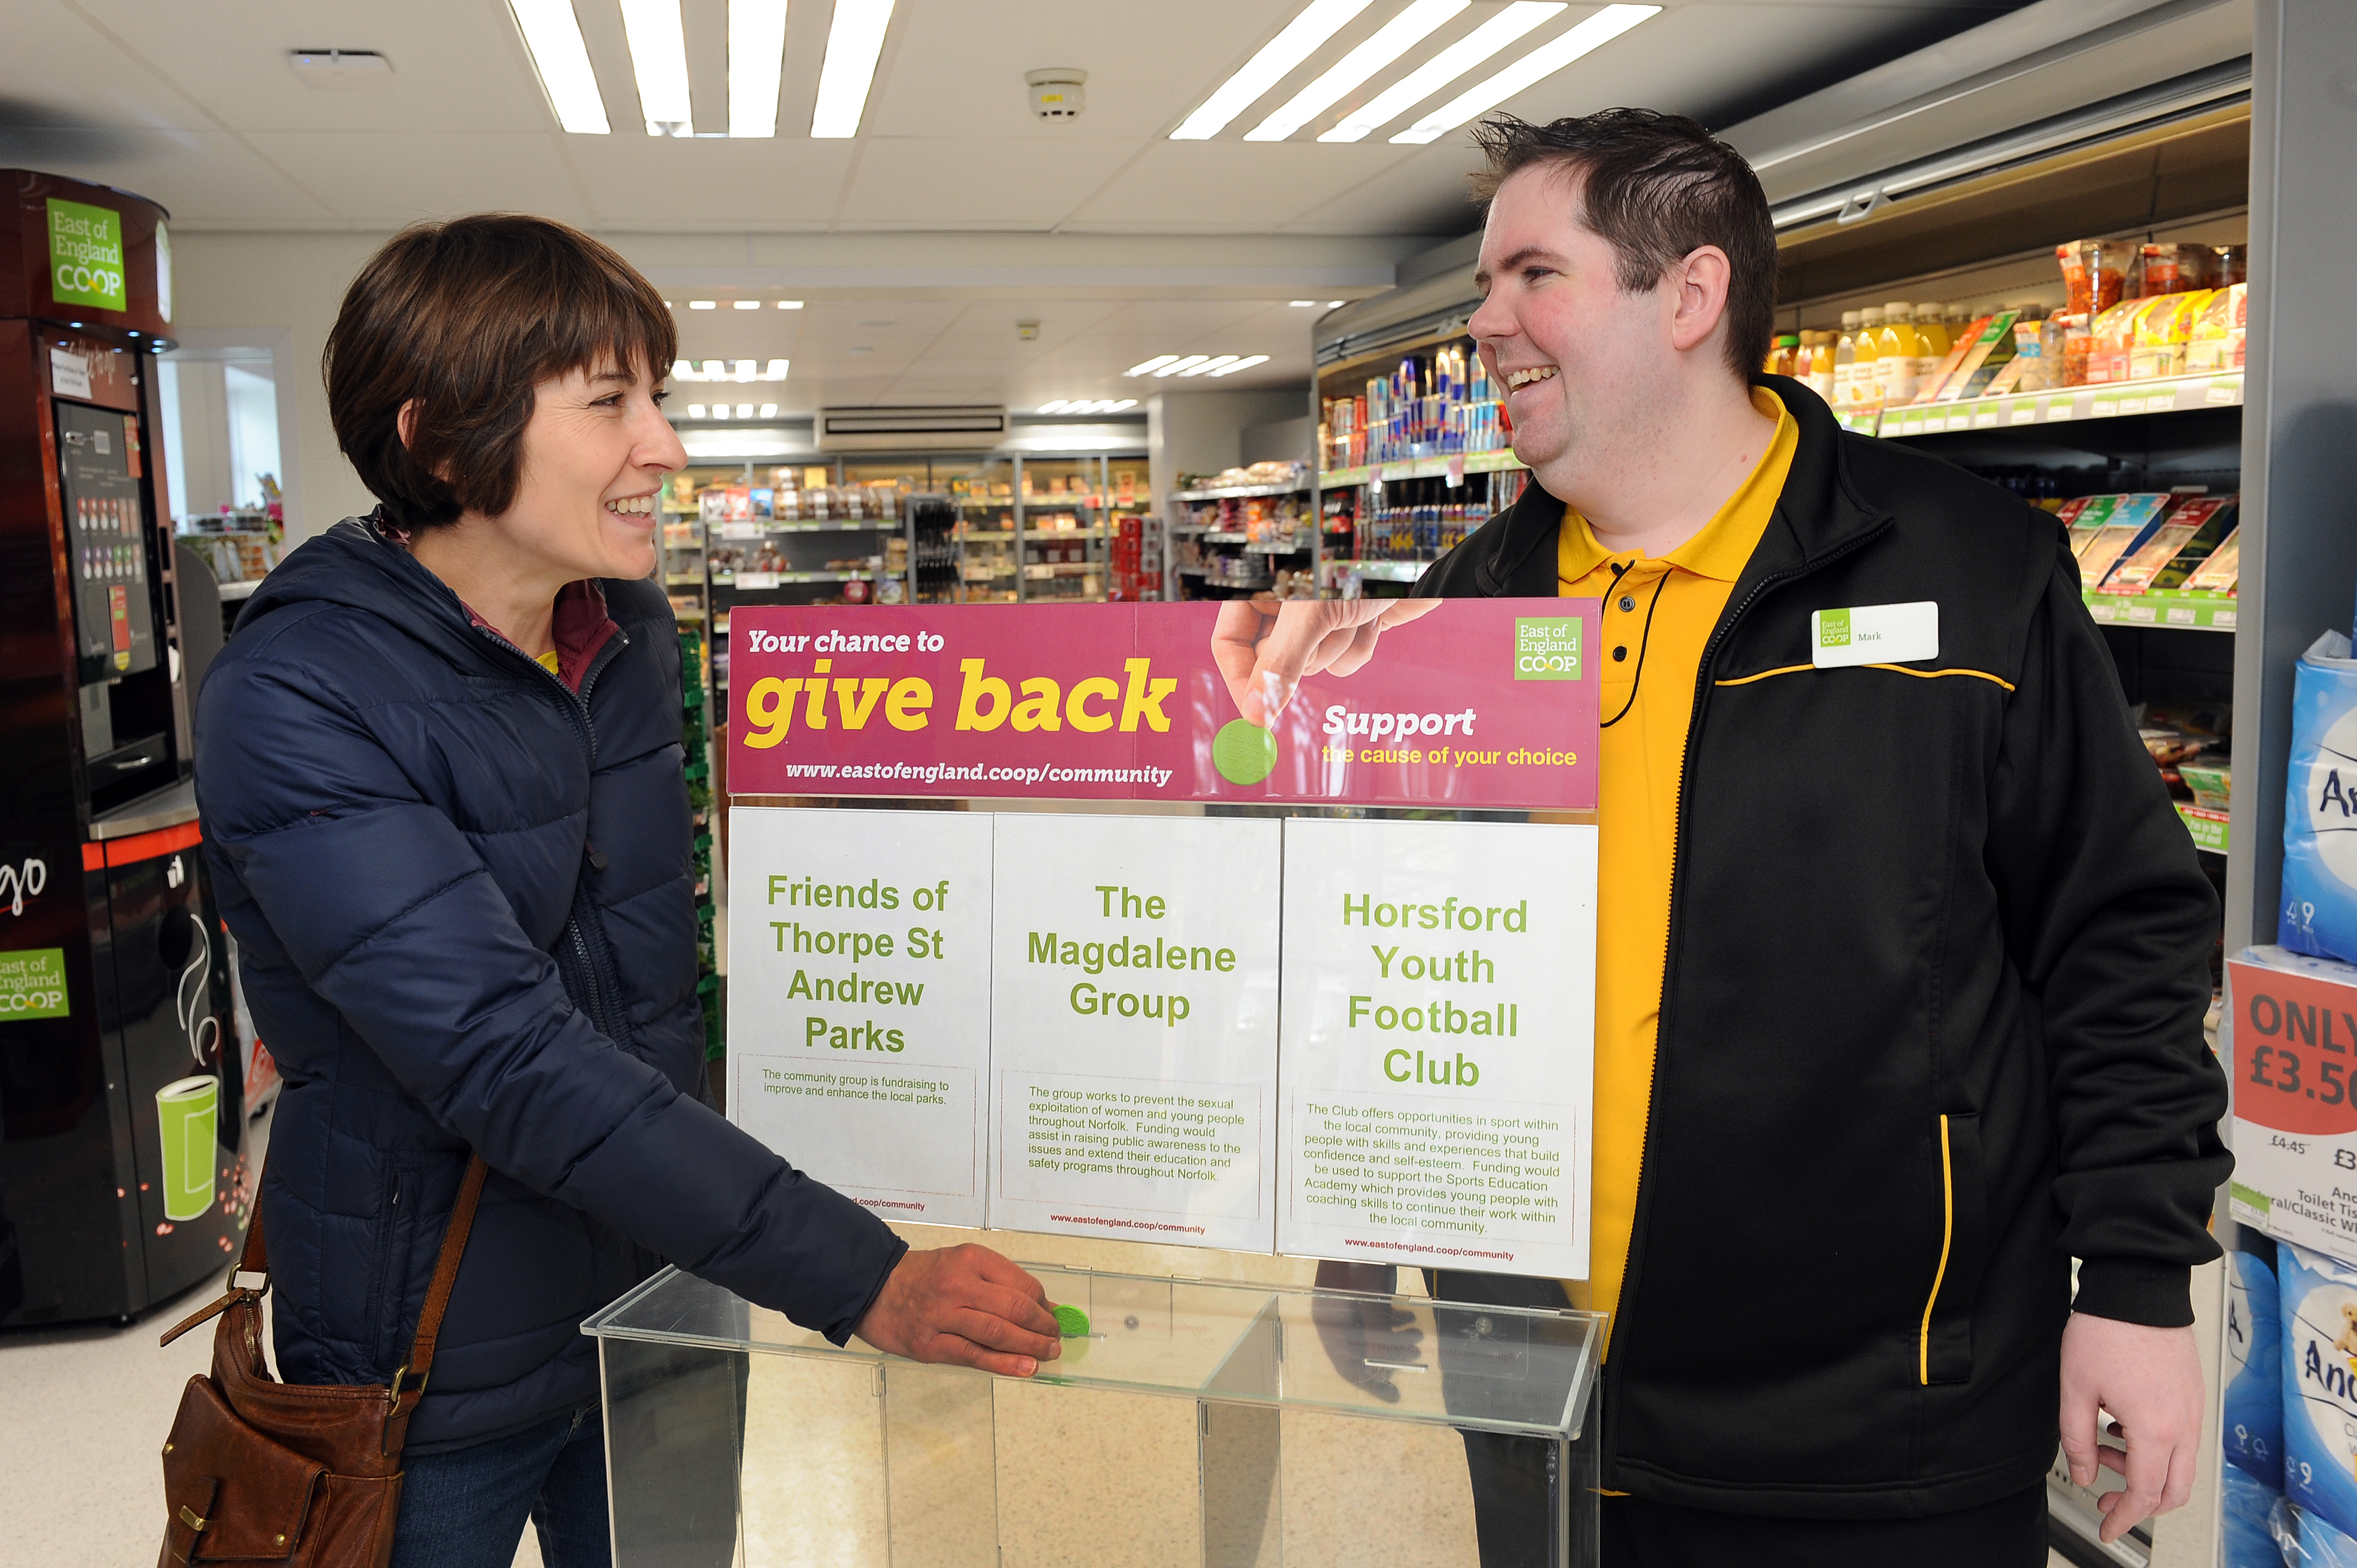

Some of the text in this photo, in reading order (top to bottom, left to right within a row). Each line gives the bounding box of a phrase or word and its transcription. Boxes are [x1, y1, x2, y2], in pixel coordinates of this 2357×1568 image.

[54, 211, 108, 240] East of
[56, 235, 119, 265] England
[749, 629, 945, 653] Your chance to
[1520, 624, 1568, 638] East of
[1822, 626, 1848, 635] England
[1858, 632, 1882, 641] Mark
[1520, 637, 1577, 655] England
[743, 658, 1178, 750] give back
[1323, 705, 1477, 743] Support
[1322, 746, 1577, 768] the cause of your choice
[786, 763, 1172, 788] www.eastofengland.coop/community
[768, 875, 949, 911] Friends of
[1095, 885, 1166, 919] The
[1344, 893, 1527, 933] Horsford
[770, 921, 944, 964] Thorpe St
[1028, 932, 1236, 974] Magdalene
[0, 956, 47, 974] ast of
[1371, 945, 1494, 983] Youth
[0, 970, 60, 993] ngland
[787, 970, 924, 1006] Andrew
[1070, 983, 1190, 1028] Group
[1349, 995, 1517, 1037] Football
[806, 1017, 905, 1053] Parks
[762, 1069, 949, 1092] The community group is fundraising to
[1384, 1049, 1480, 1087] Club
[765, 1083, 946, 1105] improve and enhance the local parks.
[1030, 1086, 1233, 1109] The group works to prevent the sexual
[1029, 1102, 1244, 1126] exploitation of women and young people
[1029, 1115, 1215, 1137] throughout Norfolk. Funding would
[1307, 1104, 1558, 1130] The Club offers opportunities in sport within
[1028, 1130, 1241, 1154] assist in raising public awareness to the
[1324, 1120, 1539, 1147] the local community, providing young
[2271, 1135, 2306, 1156] £4.45
[1029, 1143, 1231, 1167] issues and extend their education and
[1305, 1135, 1559, 1162] people with skills and experiences that build
[1029, 1158, 1219, 1181] safety programs throughout Norfolk.
[1304, 1149, 1559, 1177] confidence and self-esteem. Funding would
[1315, 1163, 1547, 1191] be used to support the Sports Education
[851, 1197, 926, 1212] d.coop/community
[1305, 1178, 1558, 1208] Academy which provides young people with
[2298, 1190, 2335, 1212] Toilet
[1306, 1194, 1555, 1222] coaching skills to continue their work within
[2271, 1197, 2337, 1227] ral/Classic
[1050, 1214, 1205, 1235] www.eastofengland.coop/community
[1370, 1212, 1487, 1235] the local community.
[1345, 1238, 1514, 1261] www.eastofengland.coop/community
